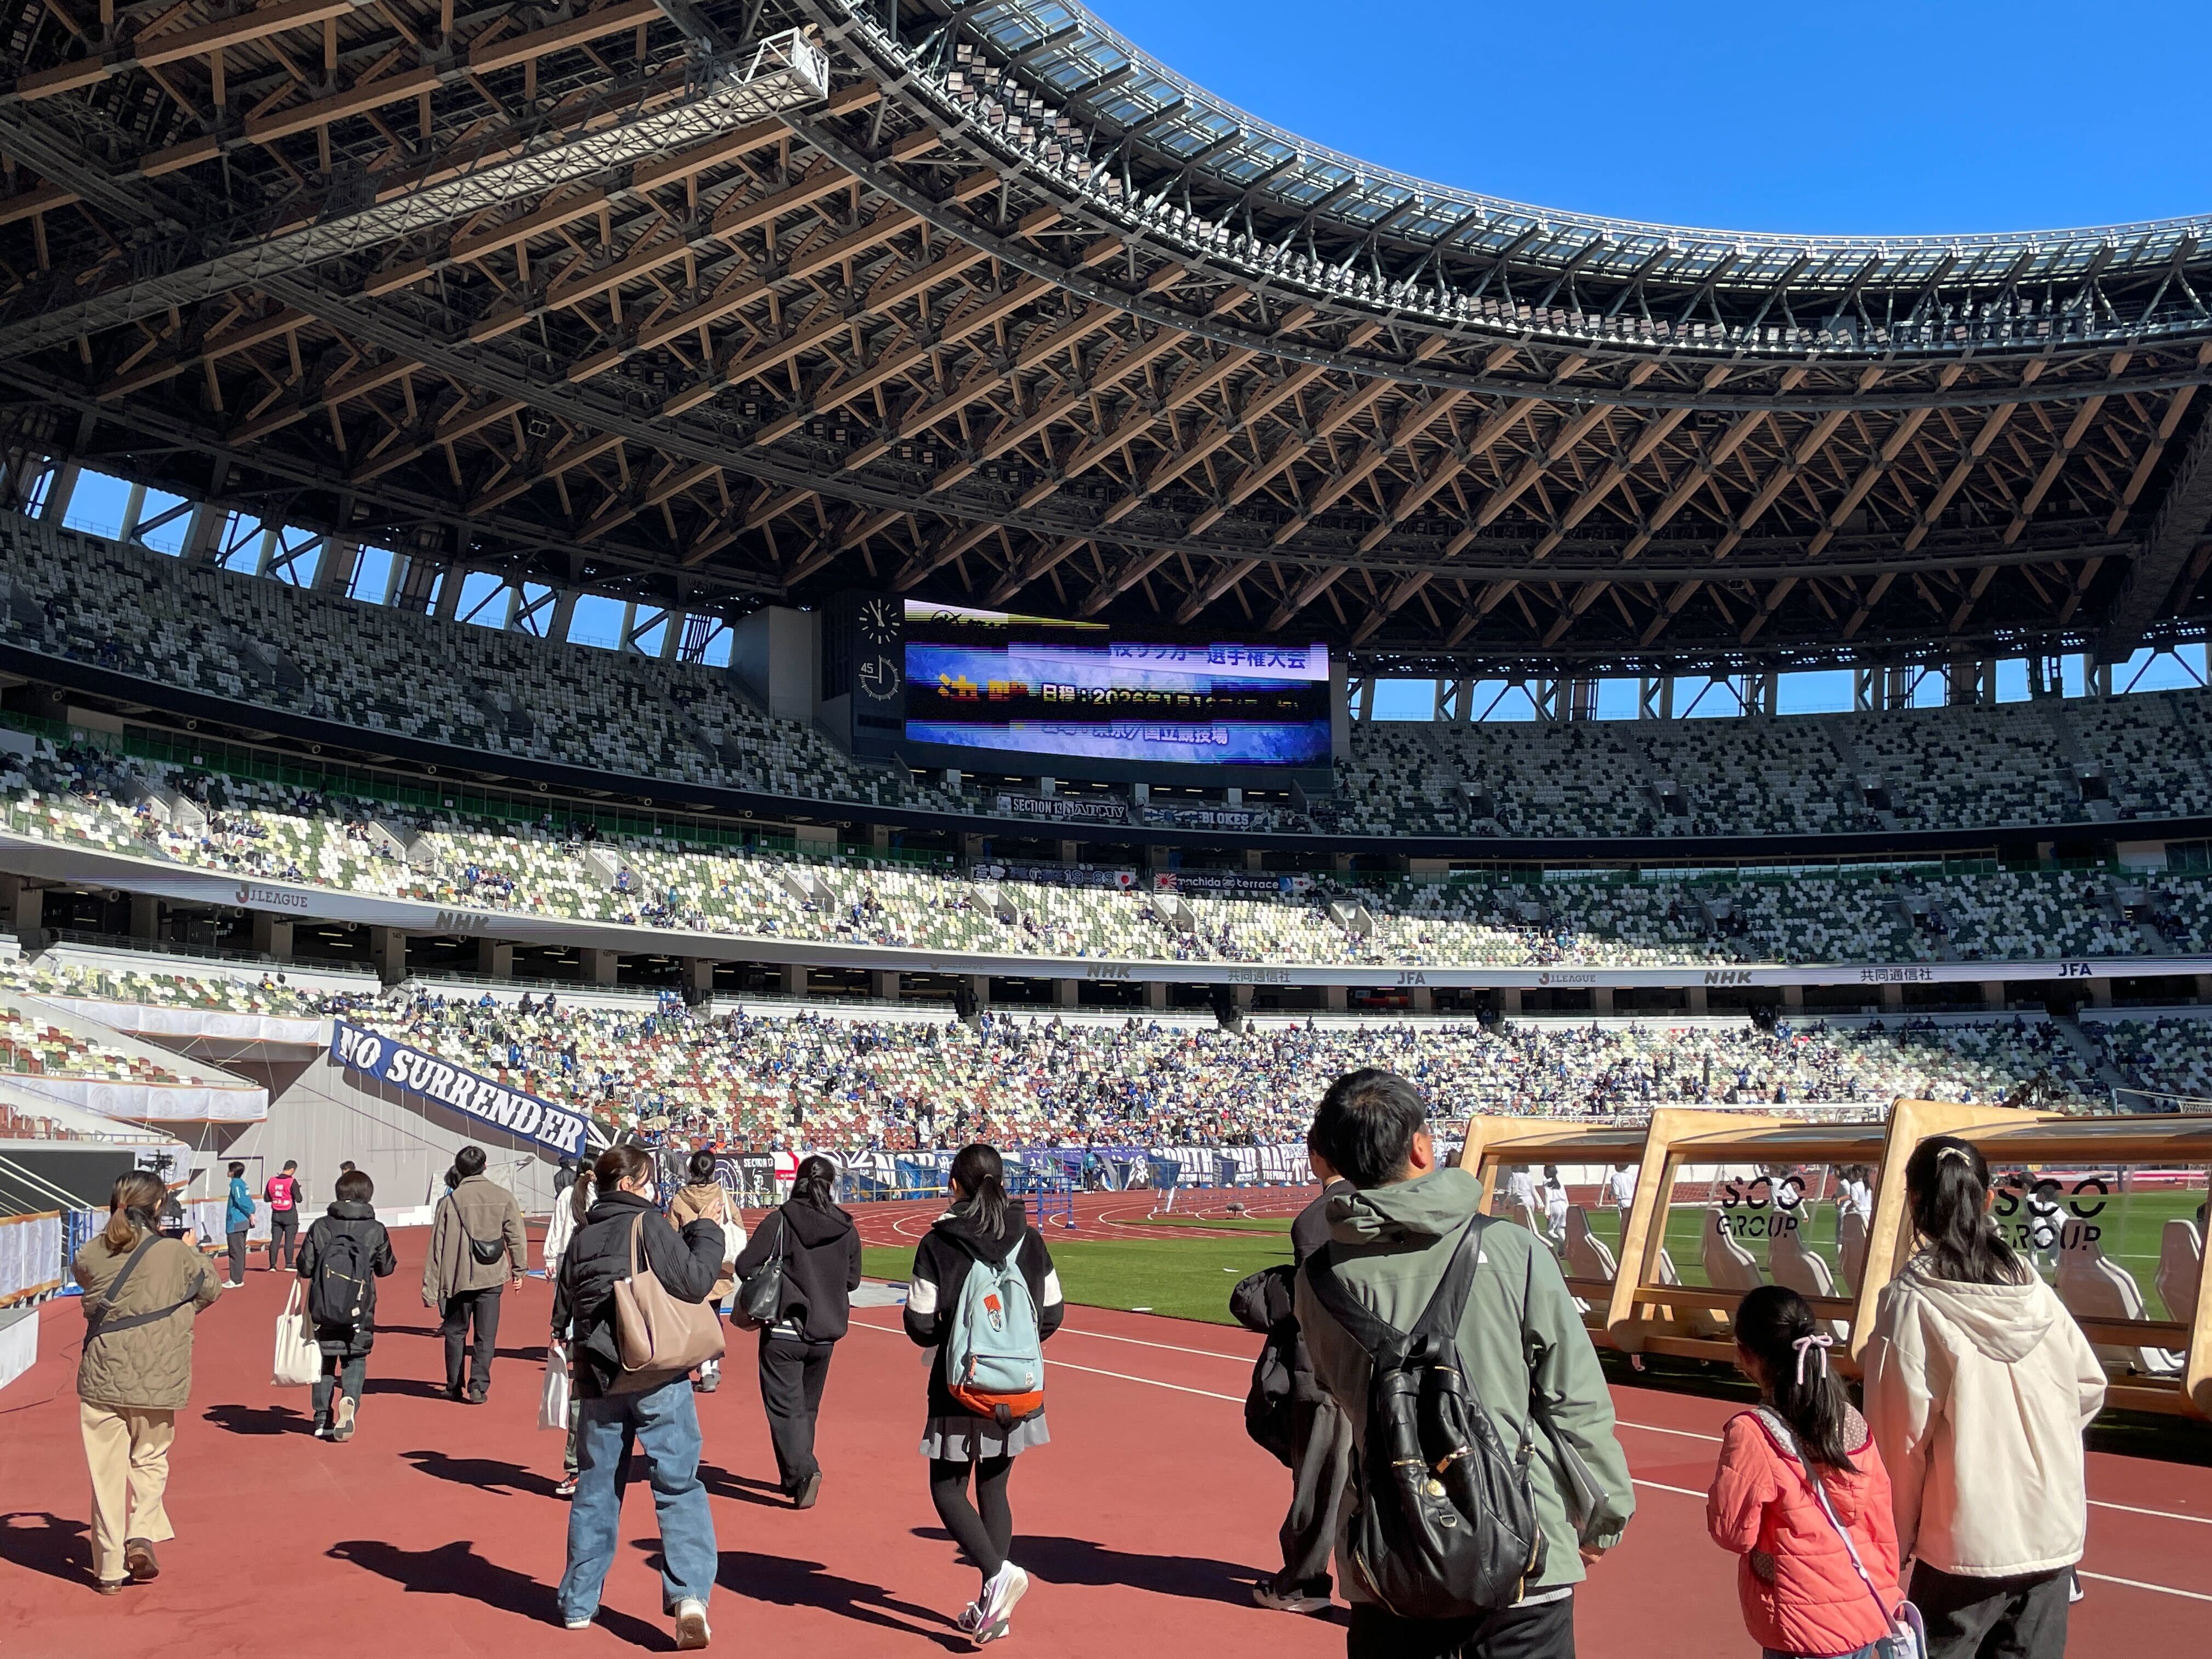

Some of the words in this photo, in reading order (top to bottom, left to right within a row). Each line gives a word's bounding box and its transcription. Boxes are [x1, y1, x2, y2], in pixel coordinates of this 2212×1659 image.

[861, 663, 874, 674] 45
[1013, 798, 1052, 814] SECTION
[1053, 802, 1063, 815] 13
[1074, 803, 1125, 817] ARMY
[1177, 877, 1221, 888] machida
[1237, 878, 1279, 889] terrace
[250, 890, 308, 908] J.LEAGUE
[436, 910, 490, 933] NHK
[1086, 963, 1131, 979] NHK
[1228, 969, 1291, 983] 共同通信社
[1397, 971, 1426, 985] JFA
[1704, 970, 1753, 985] NHK
[1860, 968, 1934, 982] 共同通信社
[2058, 963, 2093, 977] JFA
[339, 1026, 382, 1069] NO
[385, 1049, 585, 1153] SURRENDER
[1722, 1176, 1805, 1210] SCO
[1994, 1178, 2109, 1218] SCO
[1716, 1215, 1798, 1238] GROUP
[1997, 1224, 2101, 1251] GROUP
